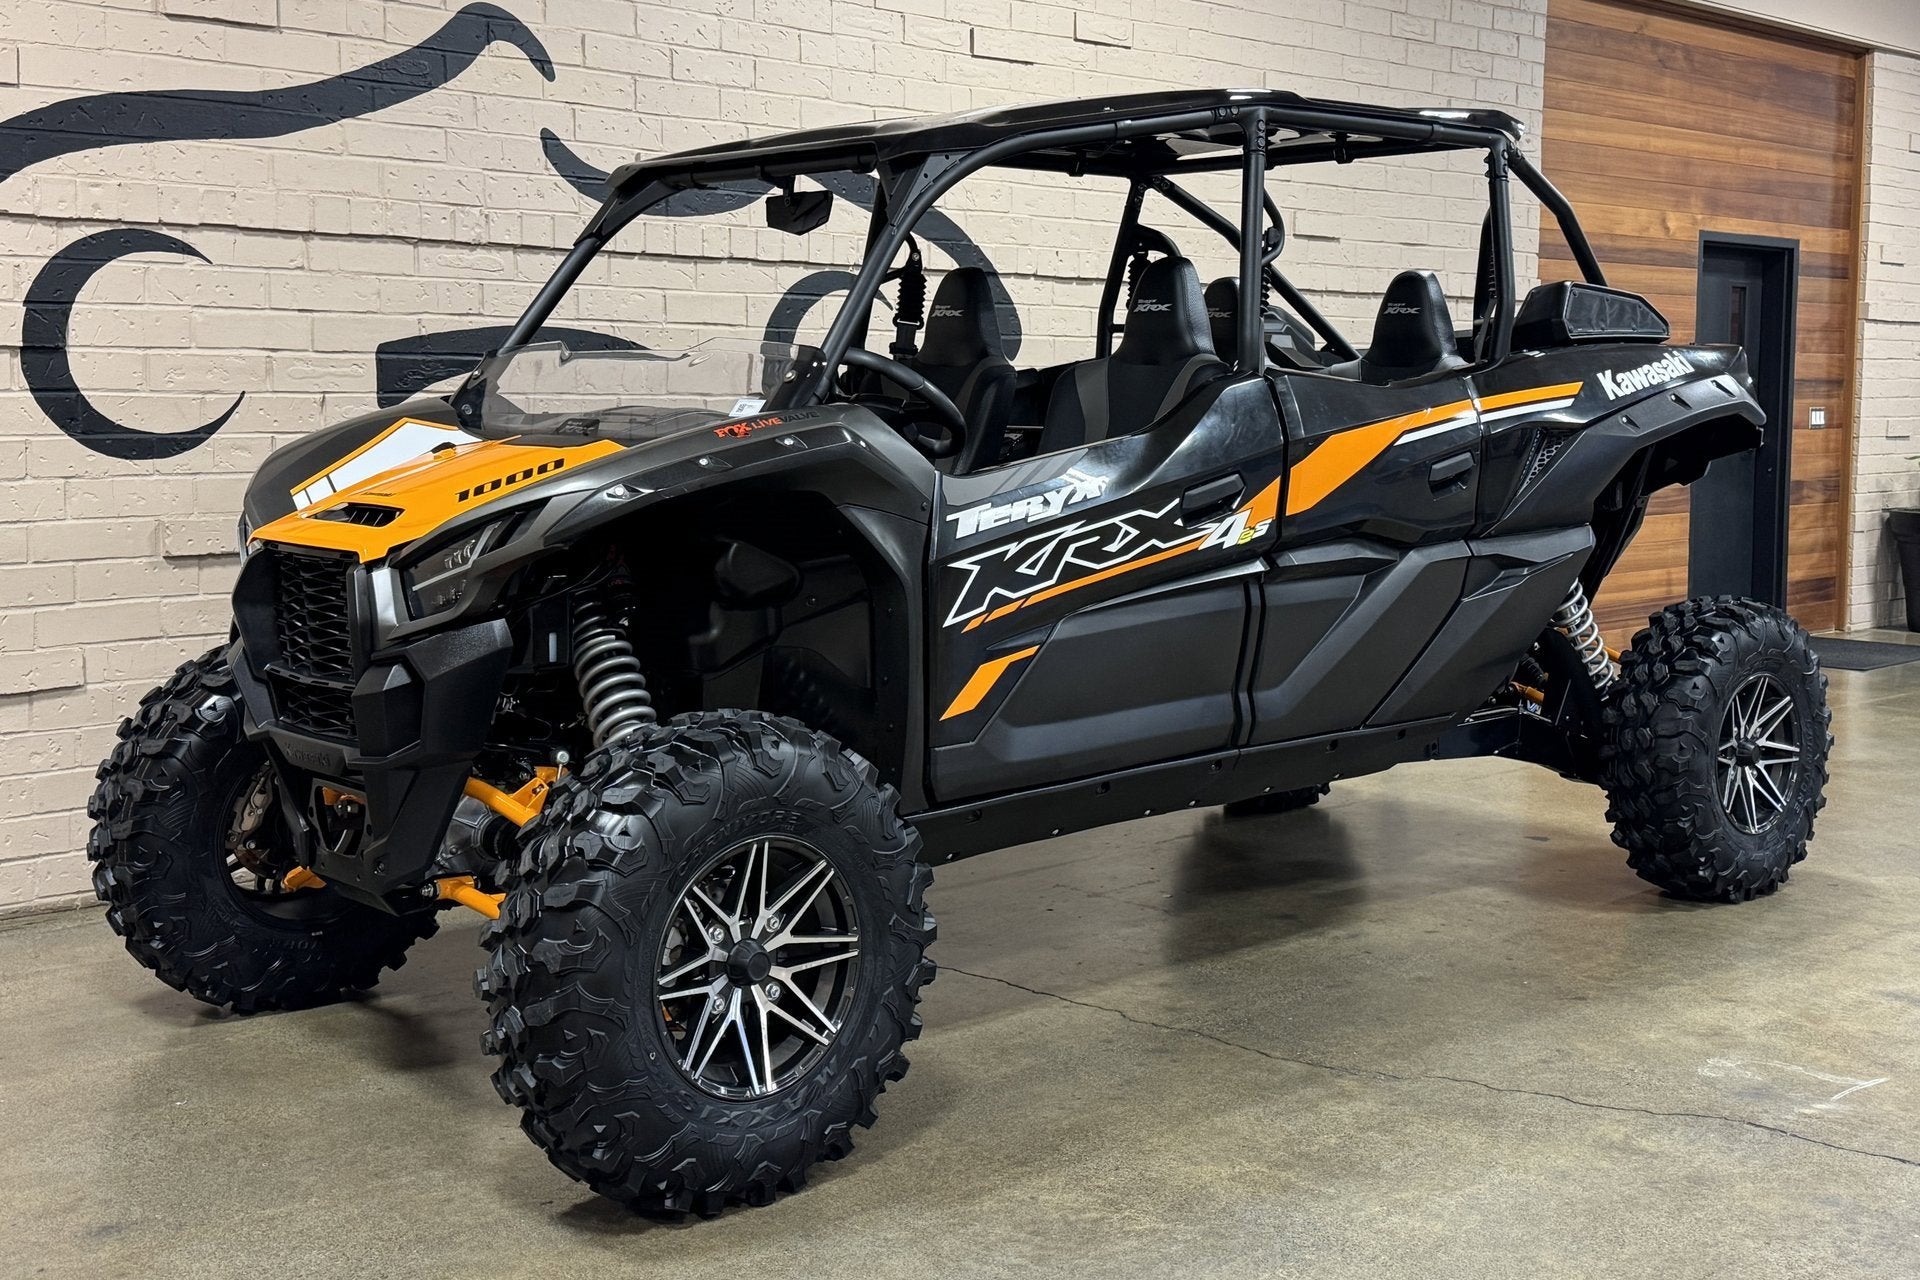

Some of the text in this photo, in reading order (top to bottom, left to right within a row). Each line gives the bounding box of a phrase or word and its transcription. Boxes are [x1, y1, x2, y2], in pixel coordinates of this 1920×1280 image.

[1597, 350, 1695, 401] Kawasaki
[713, 422, 753, 439] FOX
[455, 458, 565, 502] 1000
